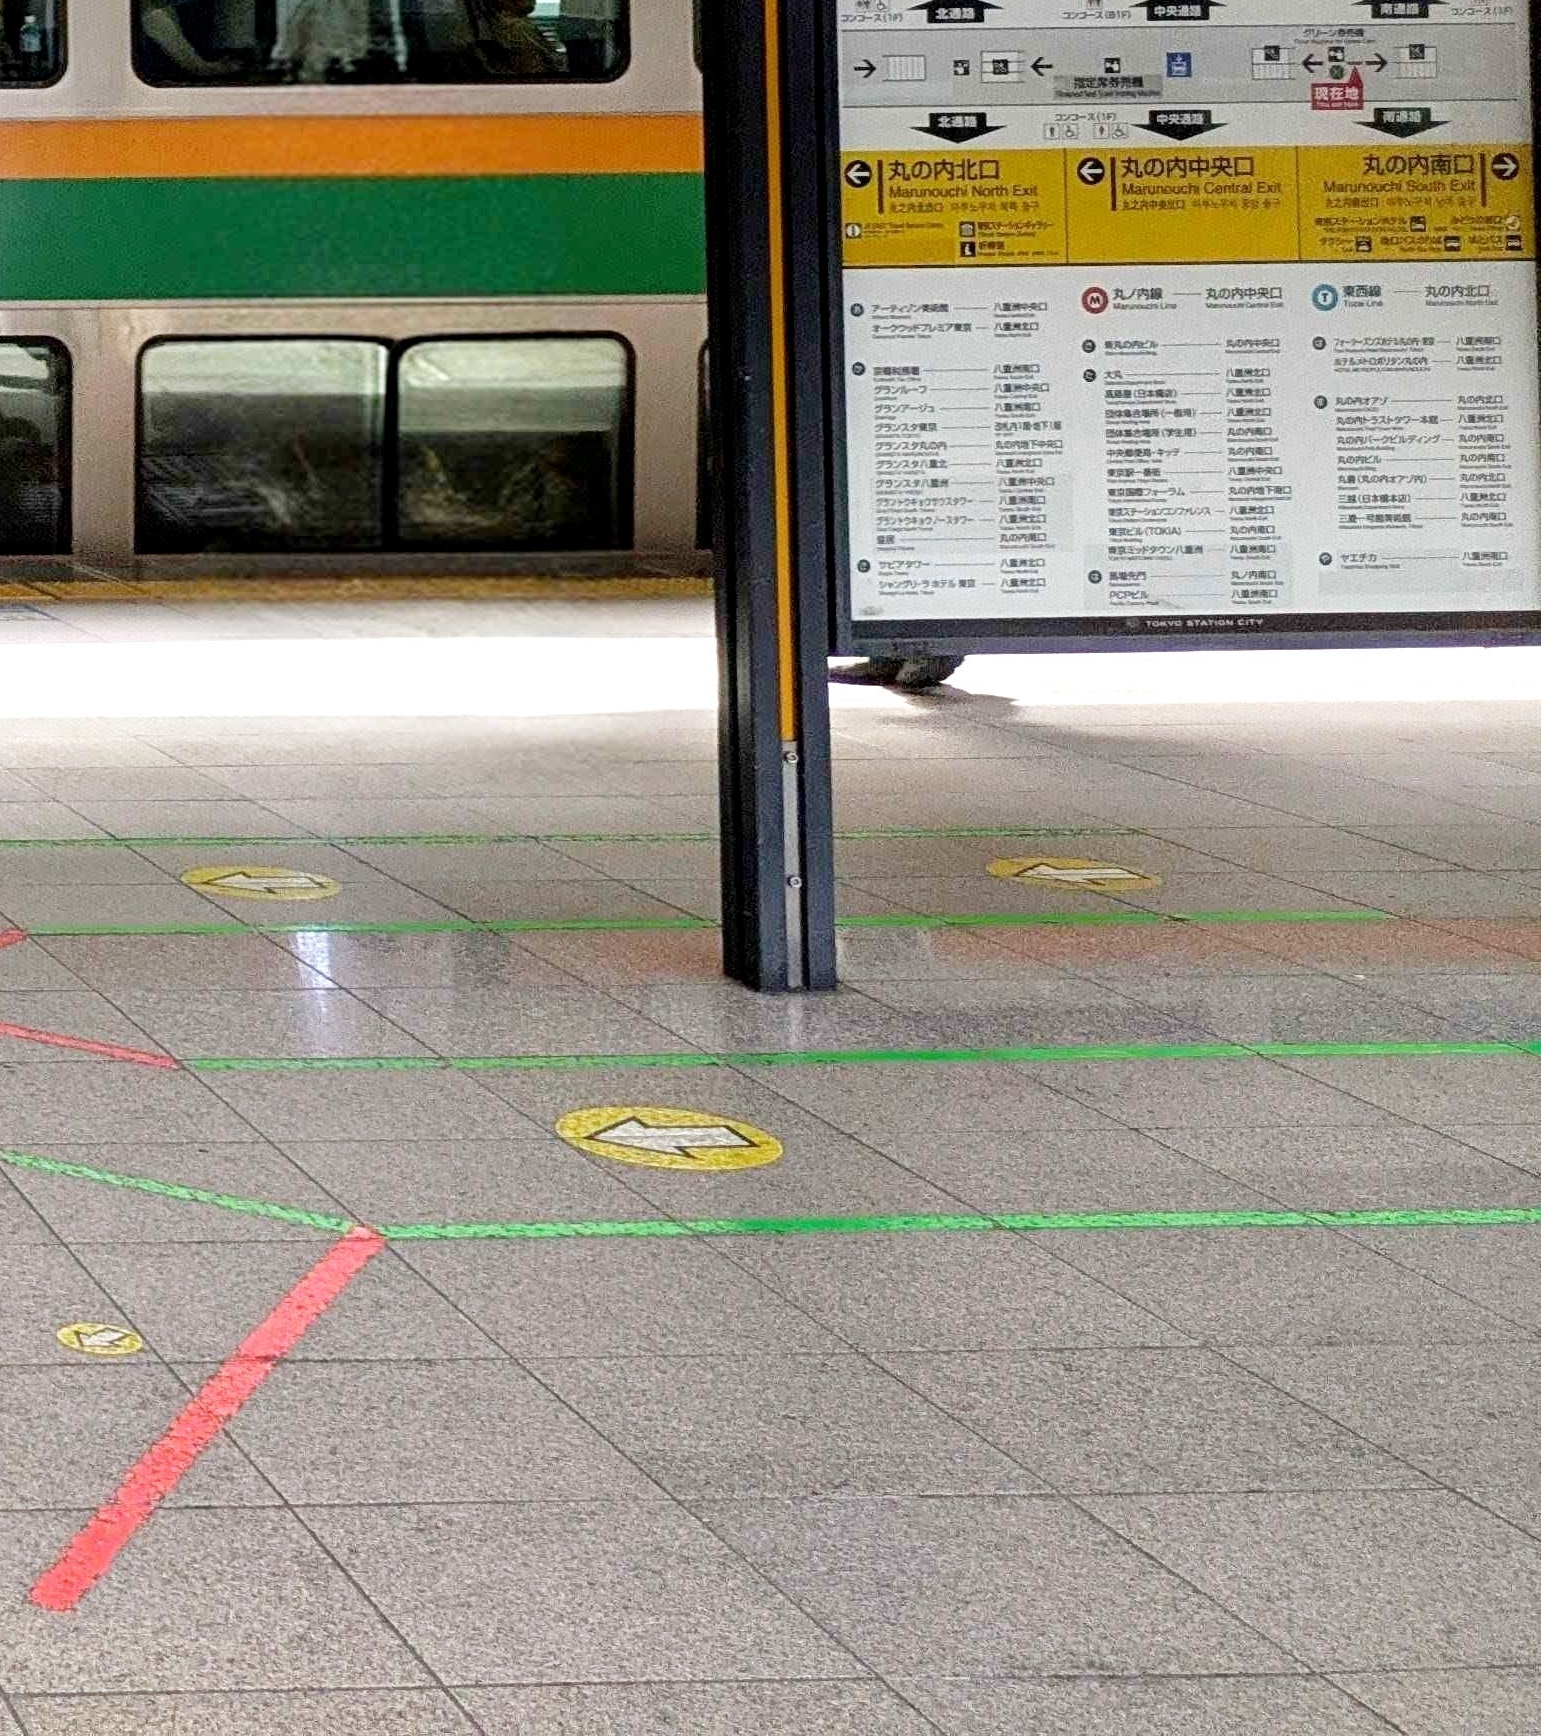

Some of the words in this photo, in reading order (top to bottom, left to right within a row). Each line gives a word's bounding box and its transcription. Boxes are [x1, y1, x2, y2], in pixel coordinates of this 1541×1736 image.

[935, 8, 975, 19] 北通路
[1154, 5, 1201, 17] 中央通路
[1314, 87, 1359, 100] 現在地
[938, 116, 977, 127] 北通路
[1156, 114, 1204, 124] 中央通路
[889, 159, 999, 181] 丸の内北口
[1121, 156, 1254, 177] 丸の内中央口
[1363, 154, 1473, 175] 丸の内南口
[889, 185, 967, 197] Marunouchi
[972, 185, 1008, 196] North
[1013, 185, 1037, 196] Exit
[1122, 183, 1199, 195] Marunouchi
[1204, 182, 1251, 194] Central
[1257, 182, 1281, 193] Exit
[1324, 180, 1402, 193] Marunouchi
[1407, 180, 1445, 192] South
[1451, 180, 1476, 191] Exit
[1113, 288, 1162, 300] 丸ノ内線
[1206, 288, 1282, 300] 丸の内中央口
[1343, 285, 1381, 297] 東西線
[1426, 285, 1489, 297] 丸の内北口
[1104, 371, 1123, 379] 大丸
[875, 423, 937, 432] グランスタ東京
[875, 442, 947, 450] グランスタ丸の内
[1338, 456, 1381, 464] 丸の内ビル
[1341, 554, 1376, 562] ヤエチカ
[1146, 620, 1181, 628] TOKYO
